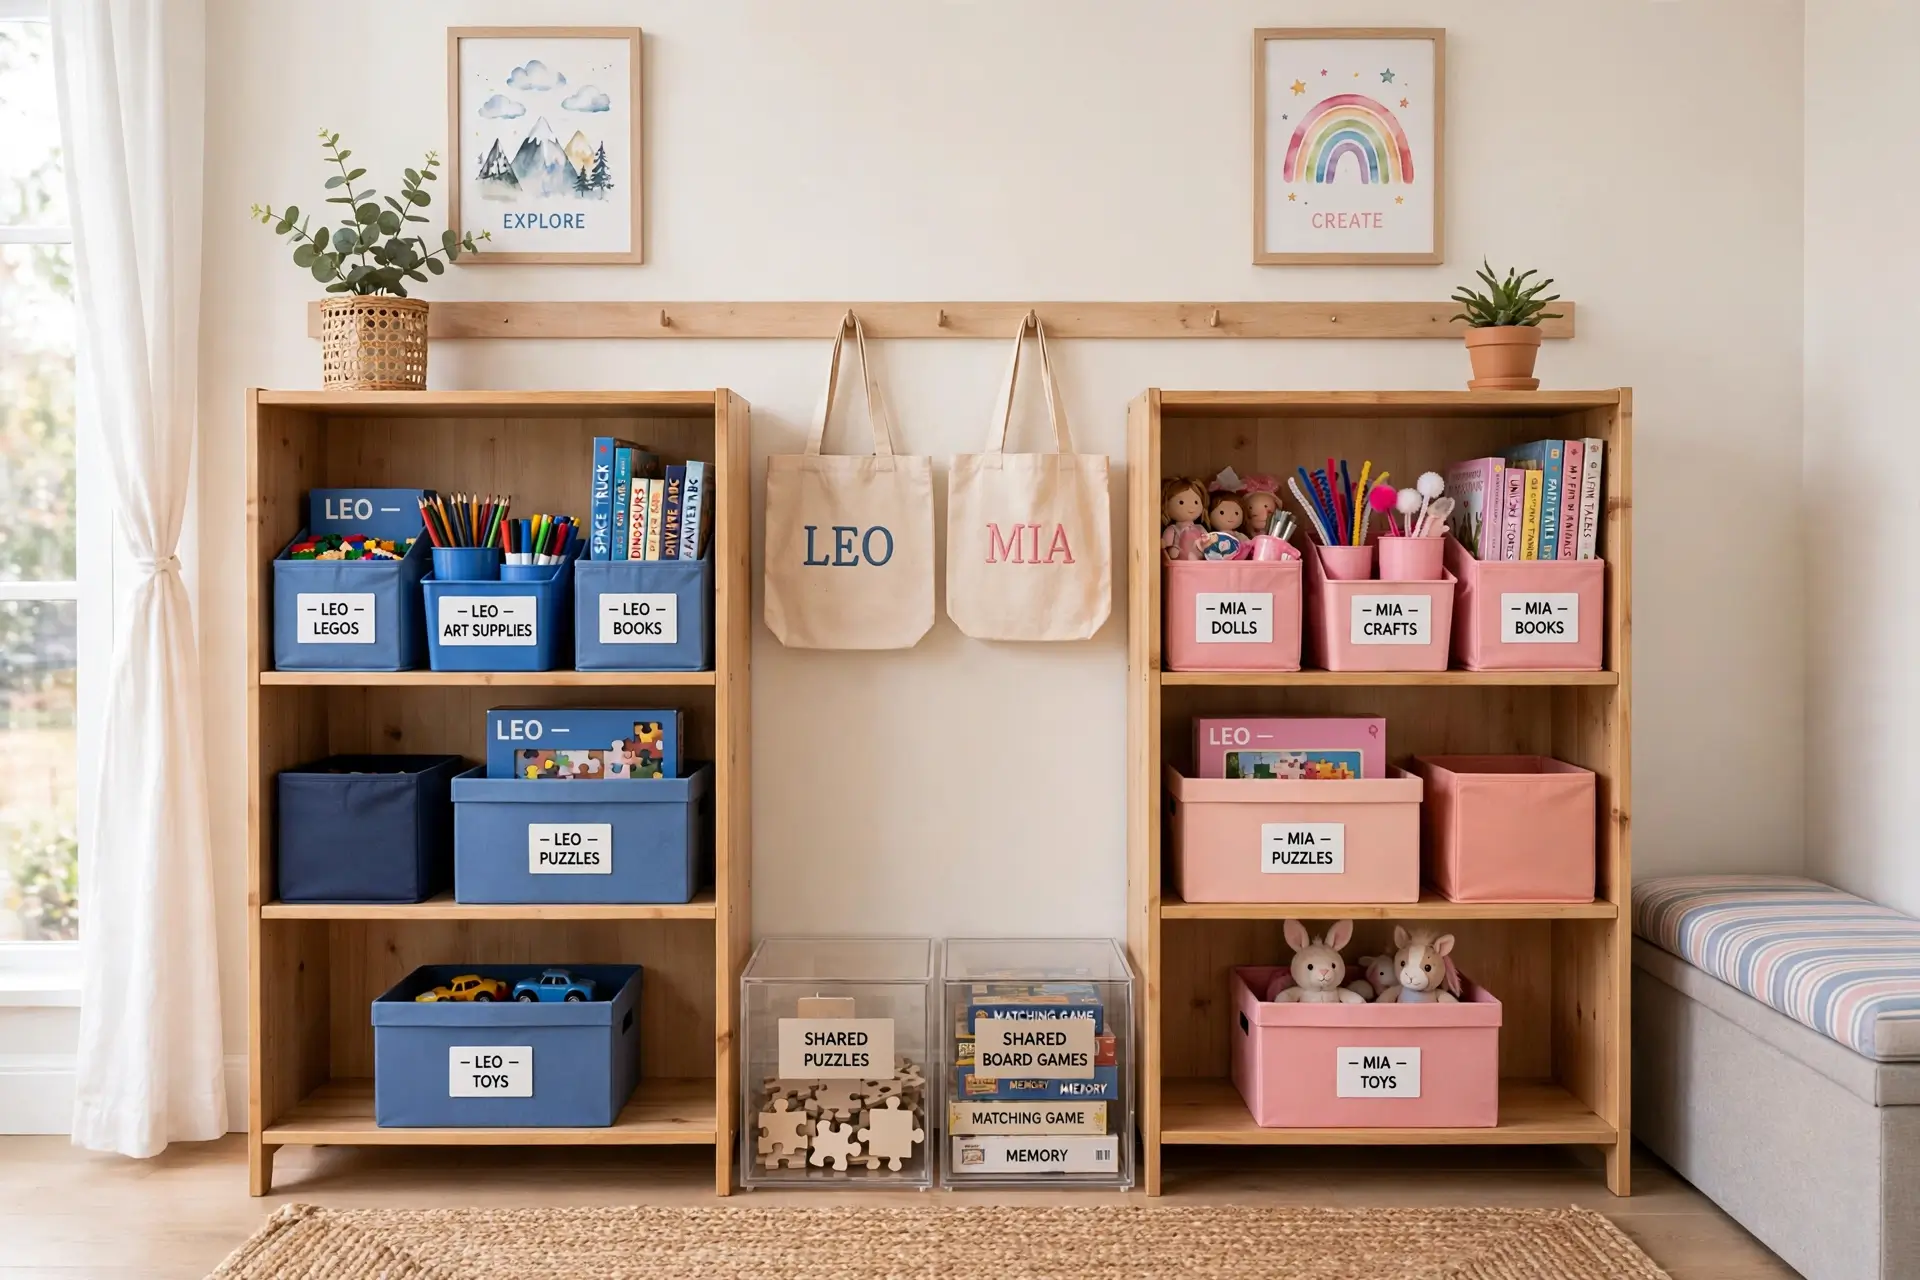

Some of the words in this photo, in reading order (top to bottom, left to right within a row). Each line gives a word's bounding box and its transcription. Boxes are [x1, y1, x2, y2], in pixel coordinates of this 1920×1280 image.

[504, 213, 584, 228] EXPLORE
[1312, 213, 1382, 228] CREATE
[595, 464, 610, 506] TRUCK
[326, 499, 373, 520] LEO
[593, 513, 607, 554] SPACE
[803, 526, 893, 566] LEO
[986, 524, 1075, 564] MIA
[322, 603, 348, 615] LEO
[472, 605, 498, 617] LEO
[624, 603, 650, 615] LEO
[1220, 602, 1246, 615] MIA
[1376, 604, 1402, 616] MIA
[1526, 602, 1552, 614] MIA
[314, 622, 359, 634] LEGOS
[444, 624, 469, 636] ART
[473, 624, 532, 636] SUPPLIES
[614, 622, 662, 635] BOOKS
[1212, 621, 1257, 634] DOLLS
[1364, 623, 1417, 635] CRAFTS
[1516, 621, 1564, 634] BOOKS
[498, 720, 542, 740] LEO
[1210, 727, 1250, 745] LEO
[555, 833, 581, 845] LEO
[1288, 832, 1314, 845] MIA
[540, 852, 599, 865] PUZZLES
[1273, 852, 1332, 864] PUZZLES
[1060, 1010, 1094, 1020] GAME
[805, 1032, 868, 1045] SHARED
[1003, 1032, 1066, 1045] SHARED
[476, 1055, 502, 1068] LEO
[805, 1053, 869, 1066] PUZZLES
[983, 1053, 1032, 1066] BOARD
[1037, 1053, 1087, 1066] GAMES
[1364, 1056, 1390, 1069] MIA
[473, 1075, 508, 1088] TOYS
[1361, 1076, 1396, 1088] TOYS
[973, 1112, 1041, 1124] MATCHING
[1046, 1112, 1084, 1124] GAME
[1007, 1149, 1068, 1162] MEMORY
